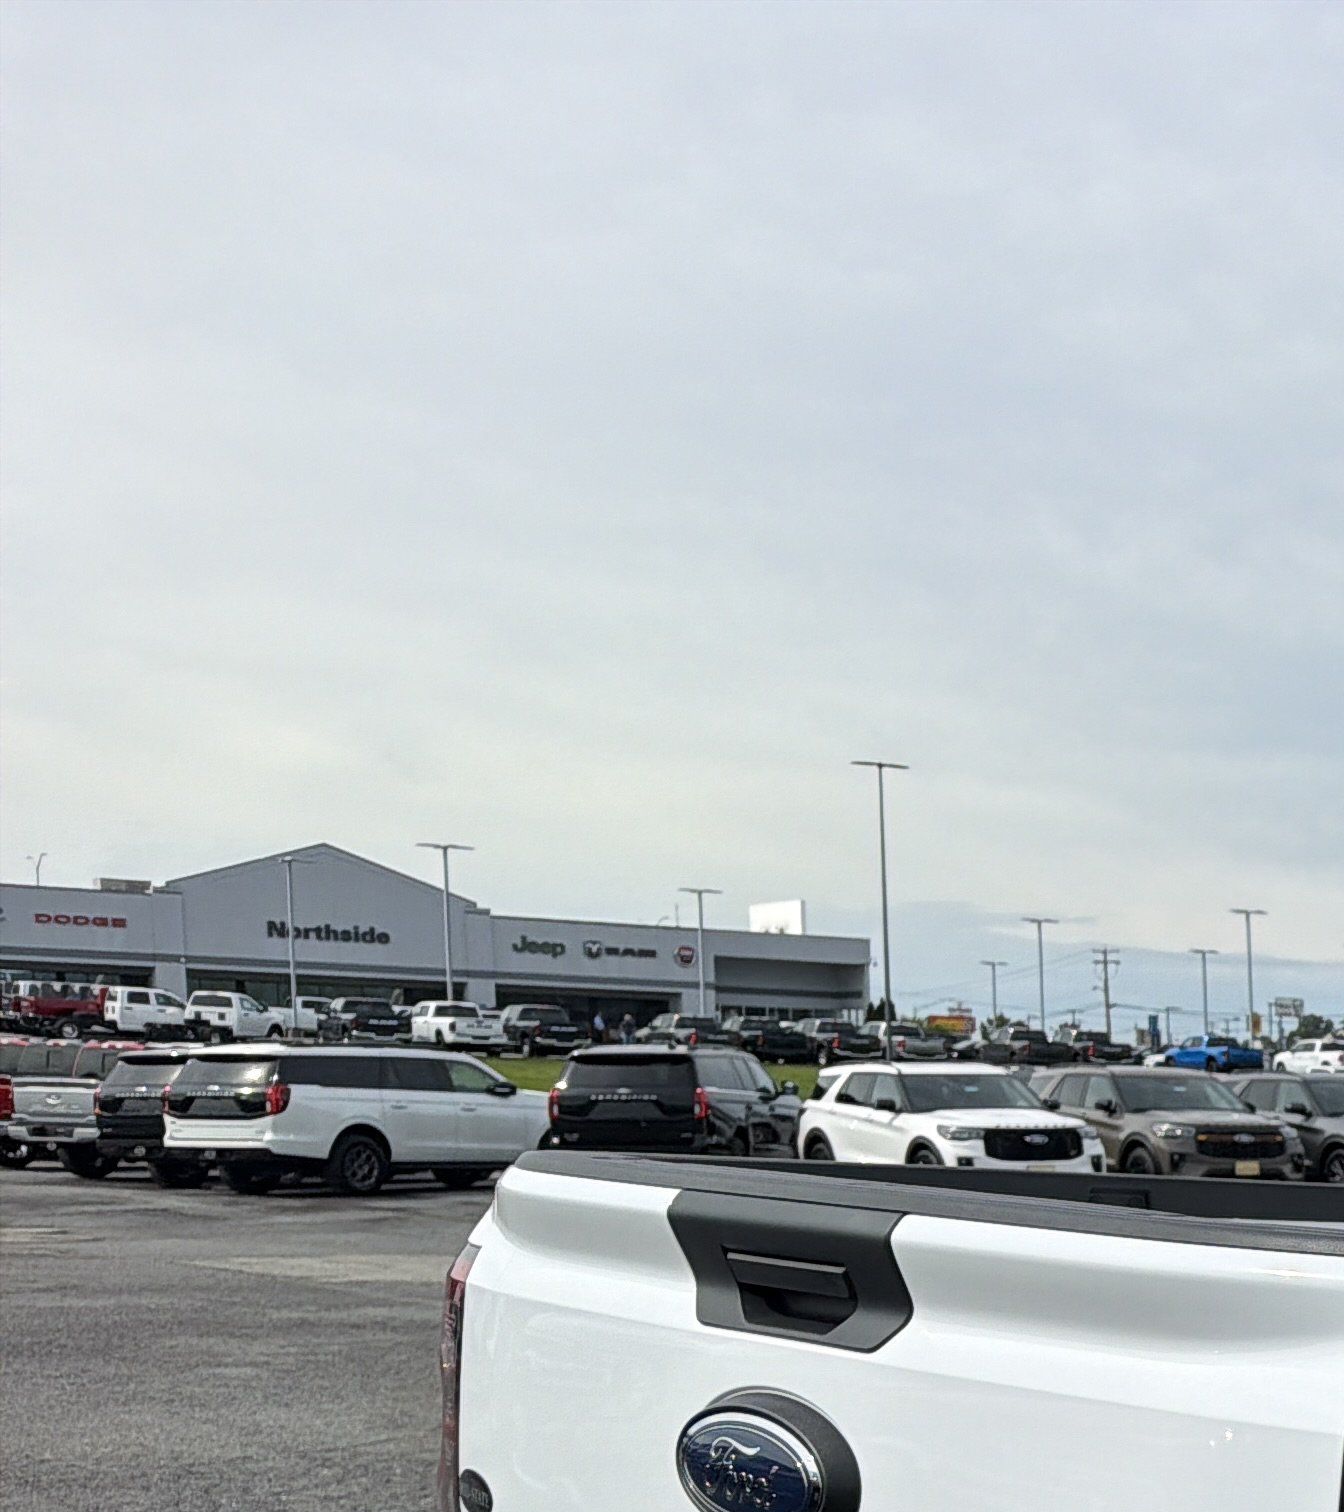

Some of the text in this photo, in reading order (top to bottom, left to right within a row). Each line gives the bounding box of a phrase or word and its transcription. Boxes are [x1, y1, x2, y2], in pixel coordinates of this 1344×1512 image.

[34, 913, 127, 928] DODGE
[266, 920, 391, 945] Northside
[512, 935, 566, 958] Jeep
